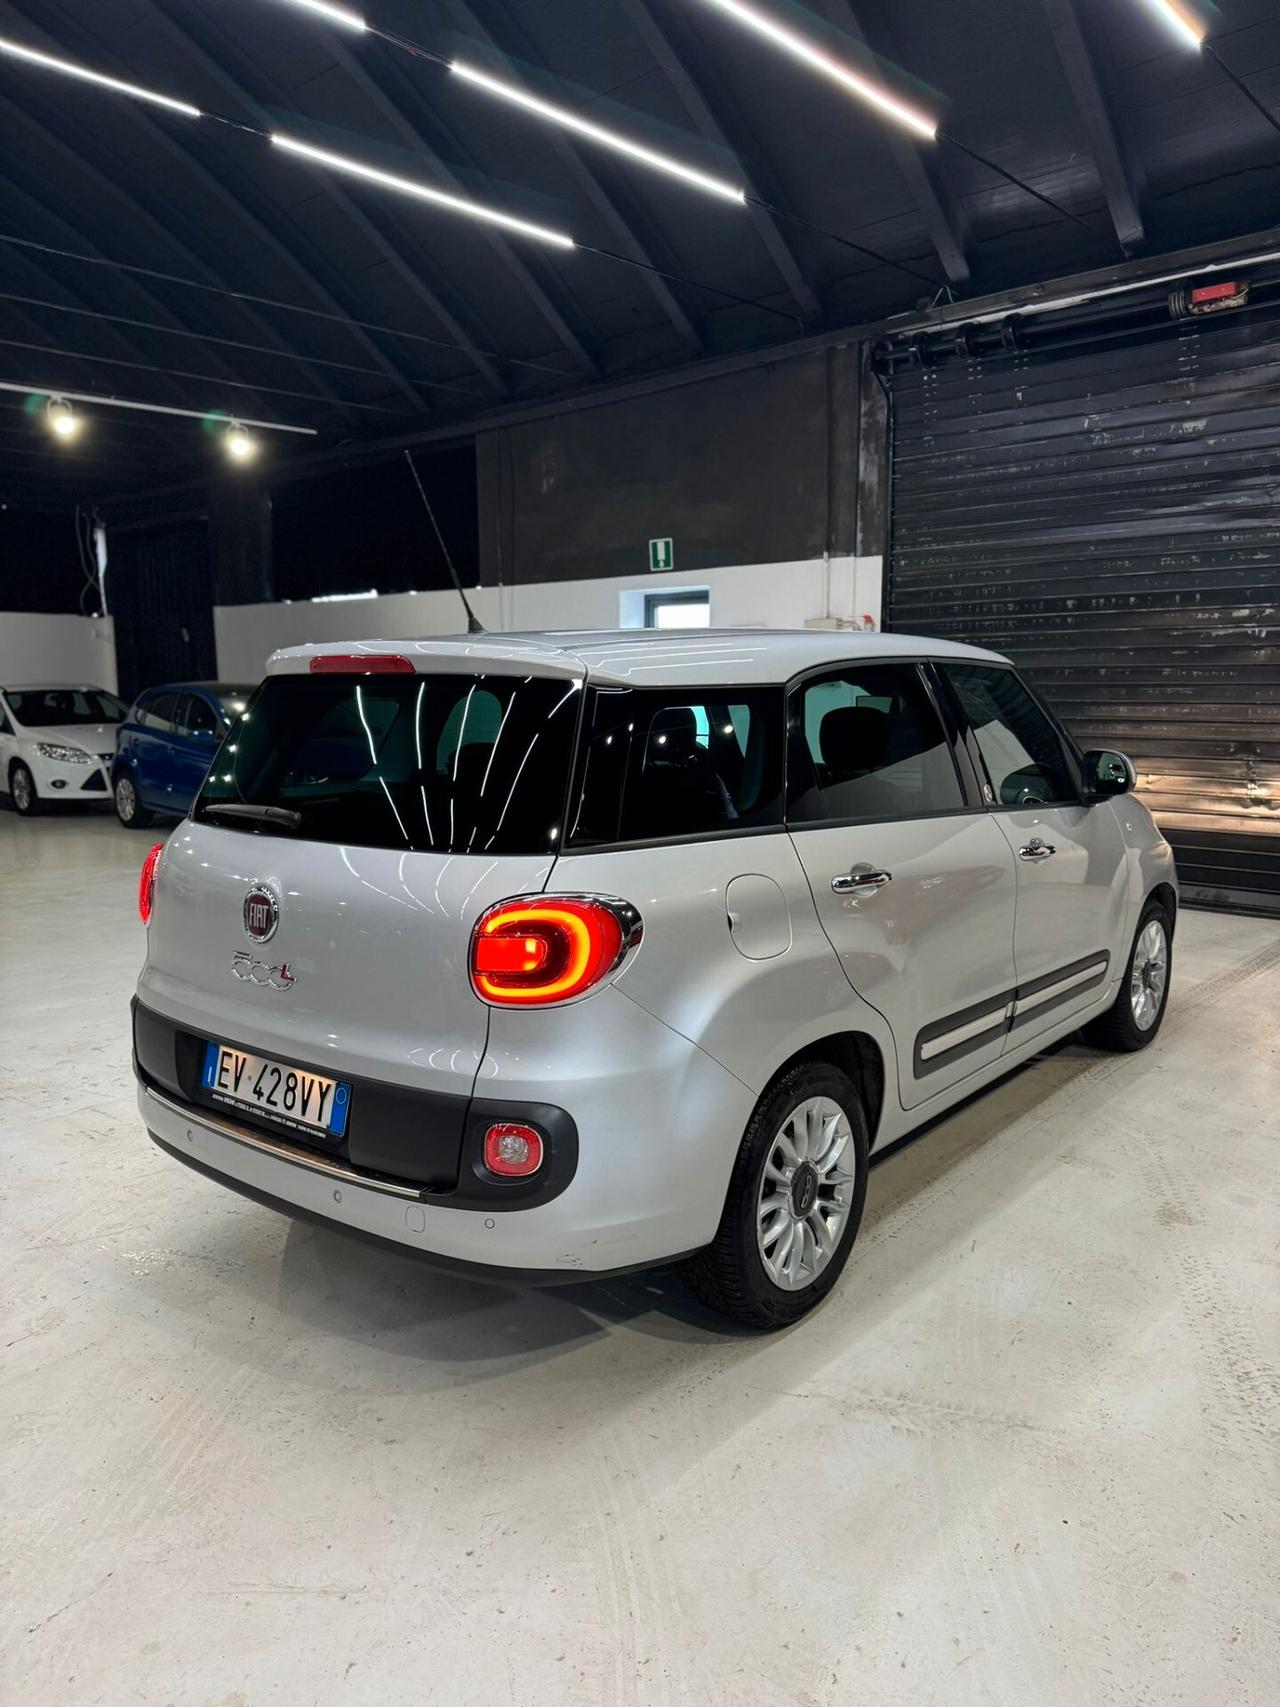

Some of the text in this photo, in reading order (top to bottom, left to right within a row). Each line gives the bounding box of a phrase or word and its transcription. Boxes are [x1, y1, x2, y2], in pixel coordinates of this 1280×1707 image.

[249, 903, 269, 929] FIAT
[217, 1050, 247, 1093] EV
[252, 1063, 332, 1122] 428VY
